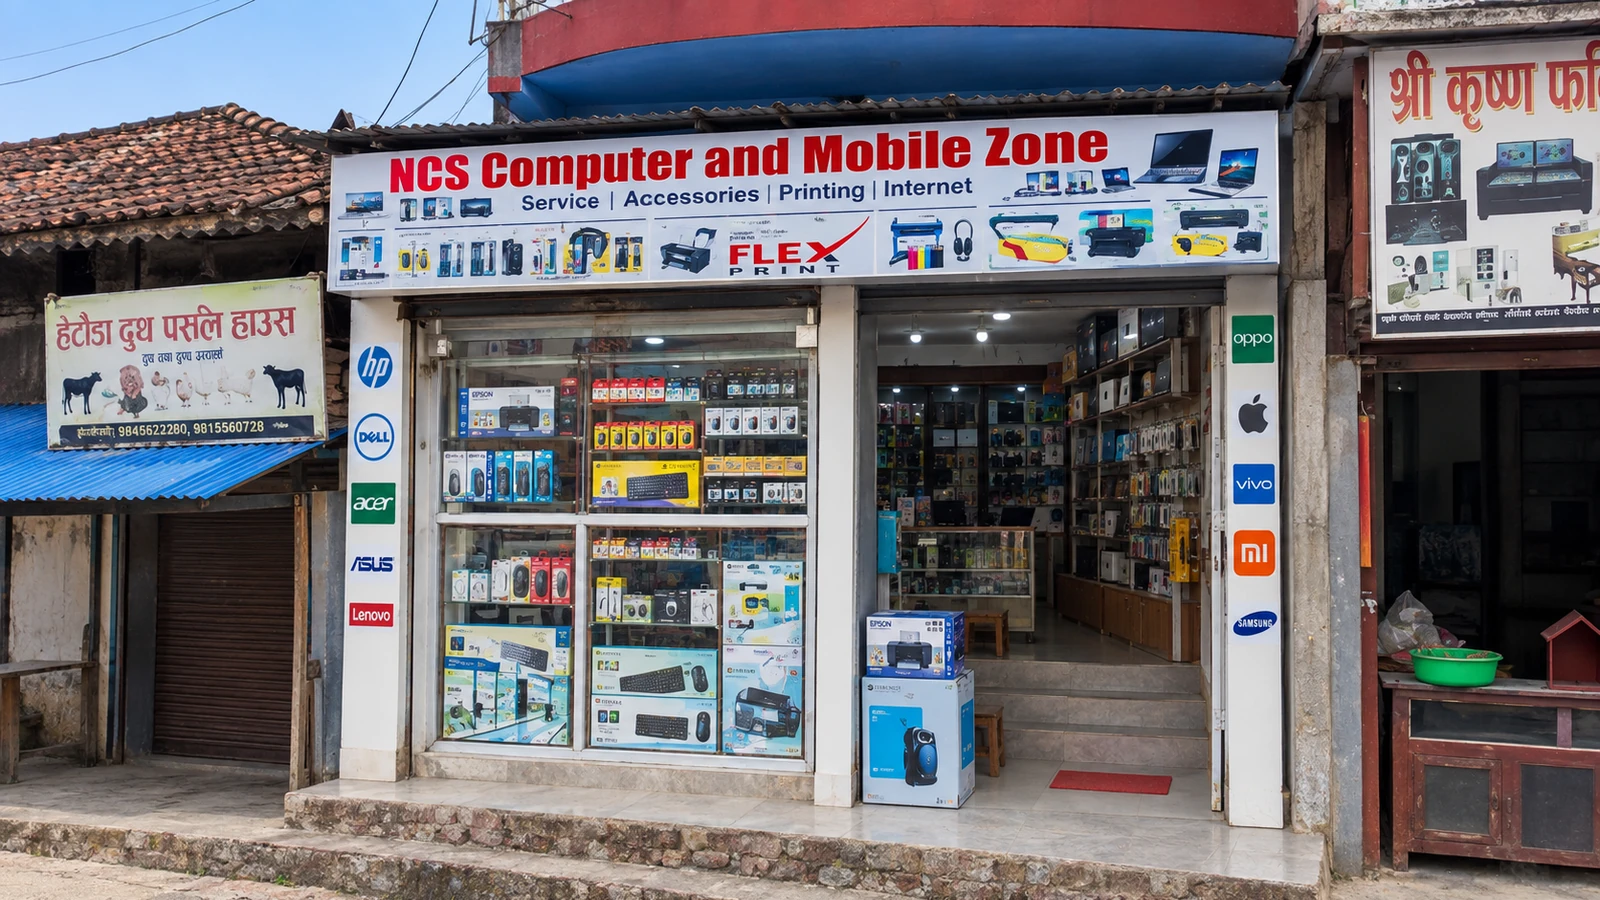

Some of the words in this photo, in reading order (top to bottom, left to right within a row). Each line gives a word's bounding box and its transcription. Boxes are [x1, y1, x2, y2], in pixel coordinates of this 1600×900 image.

[1390, 50, 1435, 124] श्री
[1446, 62, 1537, 132] कृष्ण
[390, 154, 469, 193] NCS
[482, 148, 692, 190] Computer
[705, 137, 789, 178] and
[803, 130, 971, 174] Mobile
[985, 127, 1109, 166] Zone
[521, 193, 600, 211] Service
[623, 187, 760, 207] Accessories
[779, 183, 865, 203] Printing
[884, 178, 973, 197] Internet
[730, 216, 869, 265] FLEX
[730, 264, 841, 276] PRINT
[56, 312, 113, 351] हेटौडा
[231, 307, 296, 340] हाउस
[1233, 332, 1273, 347] oppo
[360, 346, 392, 388] hp
[193, 419, 265, 435] 9815560728
[359, 431, 390, 443] DELL
[1236, 478, 1273, 490] vivo
[353, 496, 393, 511] acer
[350, 556, 394, 572] ASUS
[352, 607, 391, 622] Lenovo
[869, 620, 892, 628] EPSON
[1237, 618, 1273, 628] SAMSUNG
